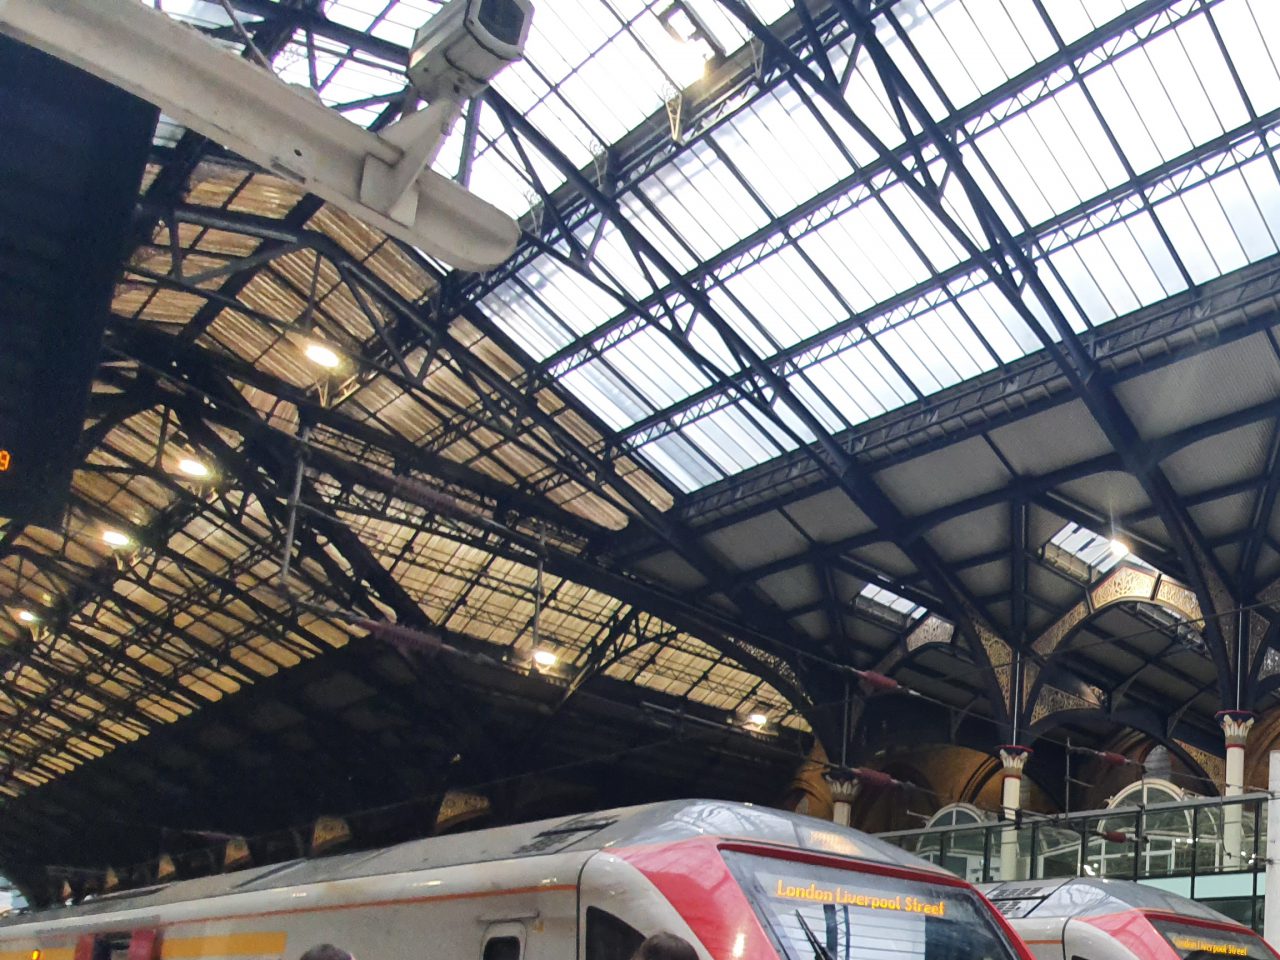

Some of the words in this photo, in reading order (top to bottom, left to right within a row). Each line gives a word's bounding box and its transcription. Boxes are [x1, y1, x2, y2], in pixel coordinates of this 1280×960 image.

[777, 879, 833, 901] London
[836, 887, 900, 910] Liverpool
[905, 896, 945, 916] Street
